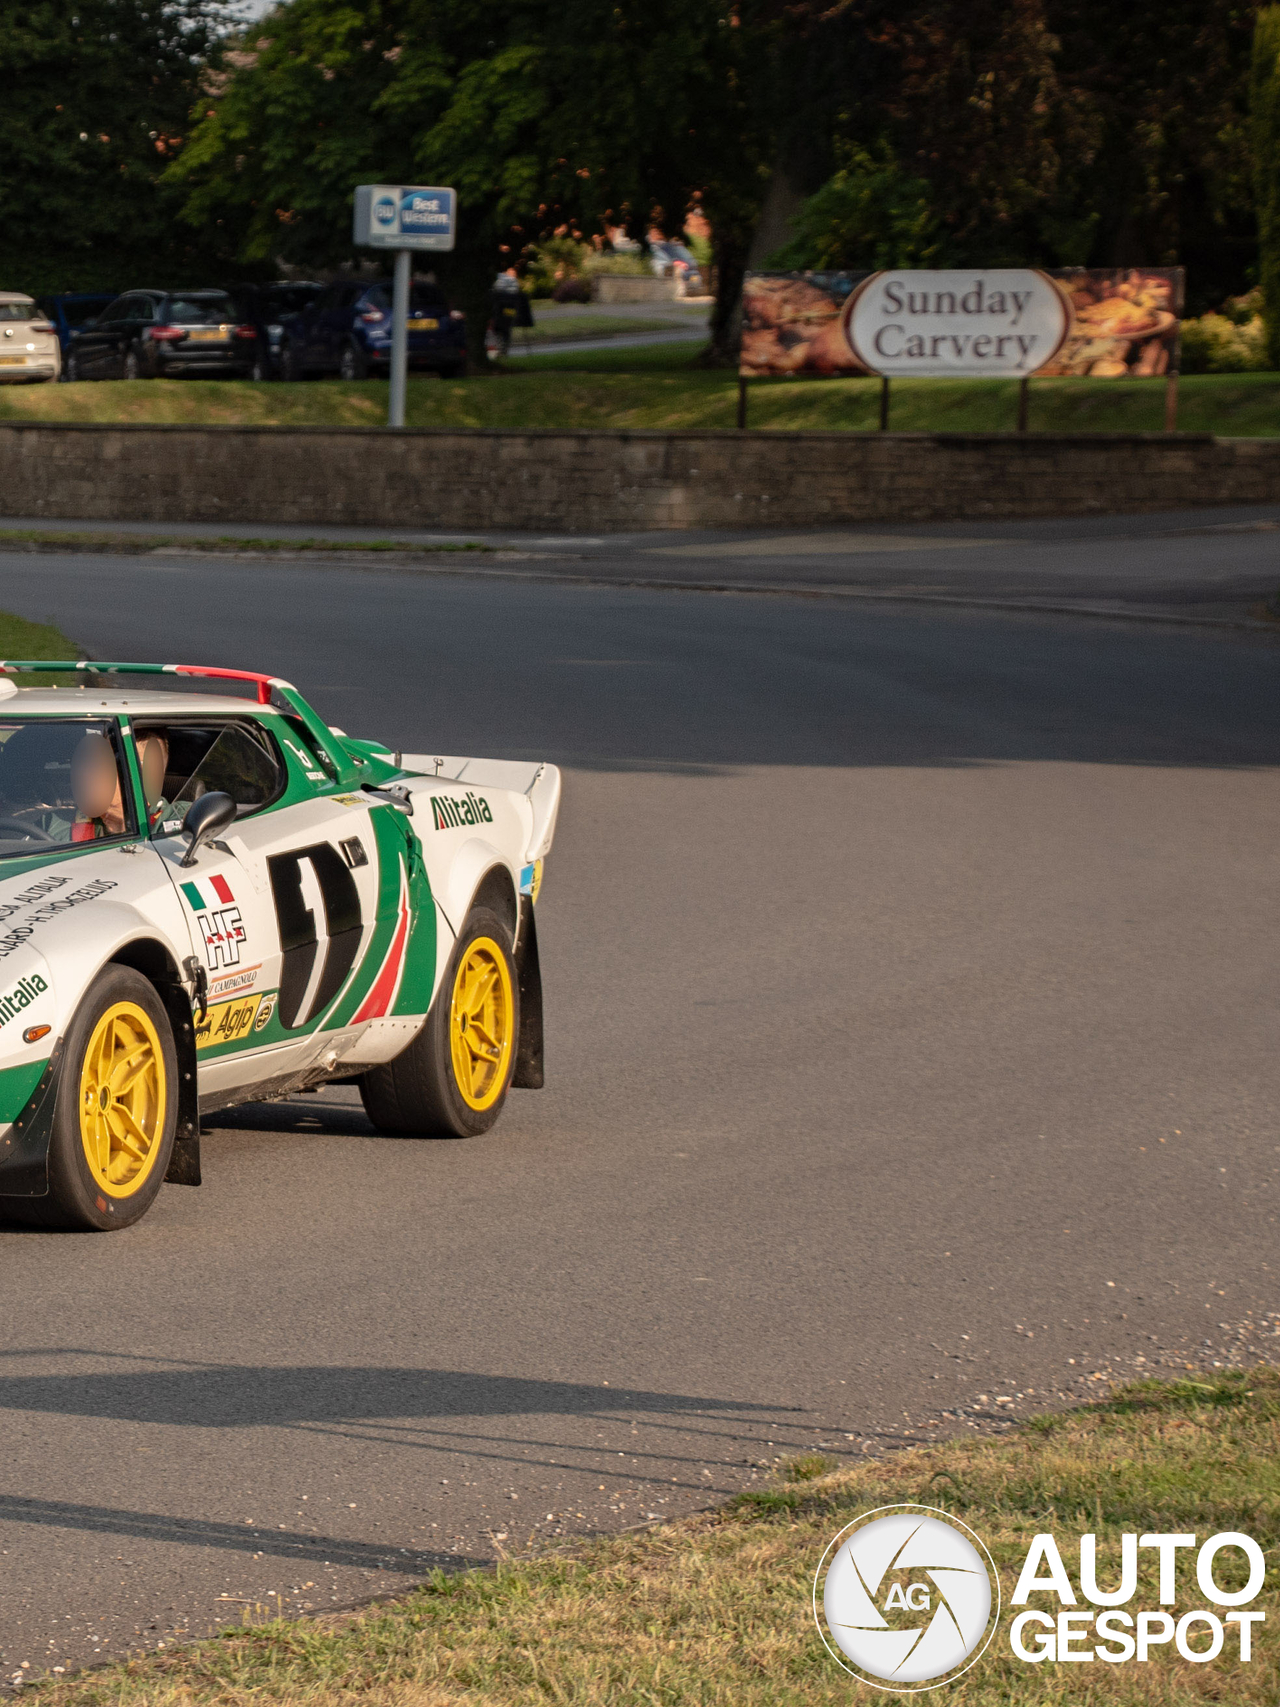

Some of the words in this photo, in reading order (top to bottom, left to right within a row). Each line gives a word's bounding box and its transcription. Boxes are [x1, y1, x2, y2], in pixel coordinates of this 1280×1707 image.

[412, 197, 440, 210] Best
[882, 279, 1034, 325] Sunday
[874, 323, 1039, 369] Carvery
[429, 791, 494, 831] Alitalia
[13, 875, 74, 904] ALITALIA
[197, 906, 247, 971] HF
[214, 970, 258, 994] CAMPAGNOLO
[214, 1001, 254, 1040] Agip
